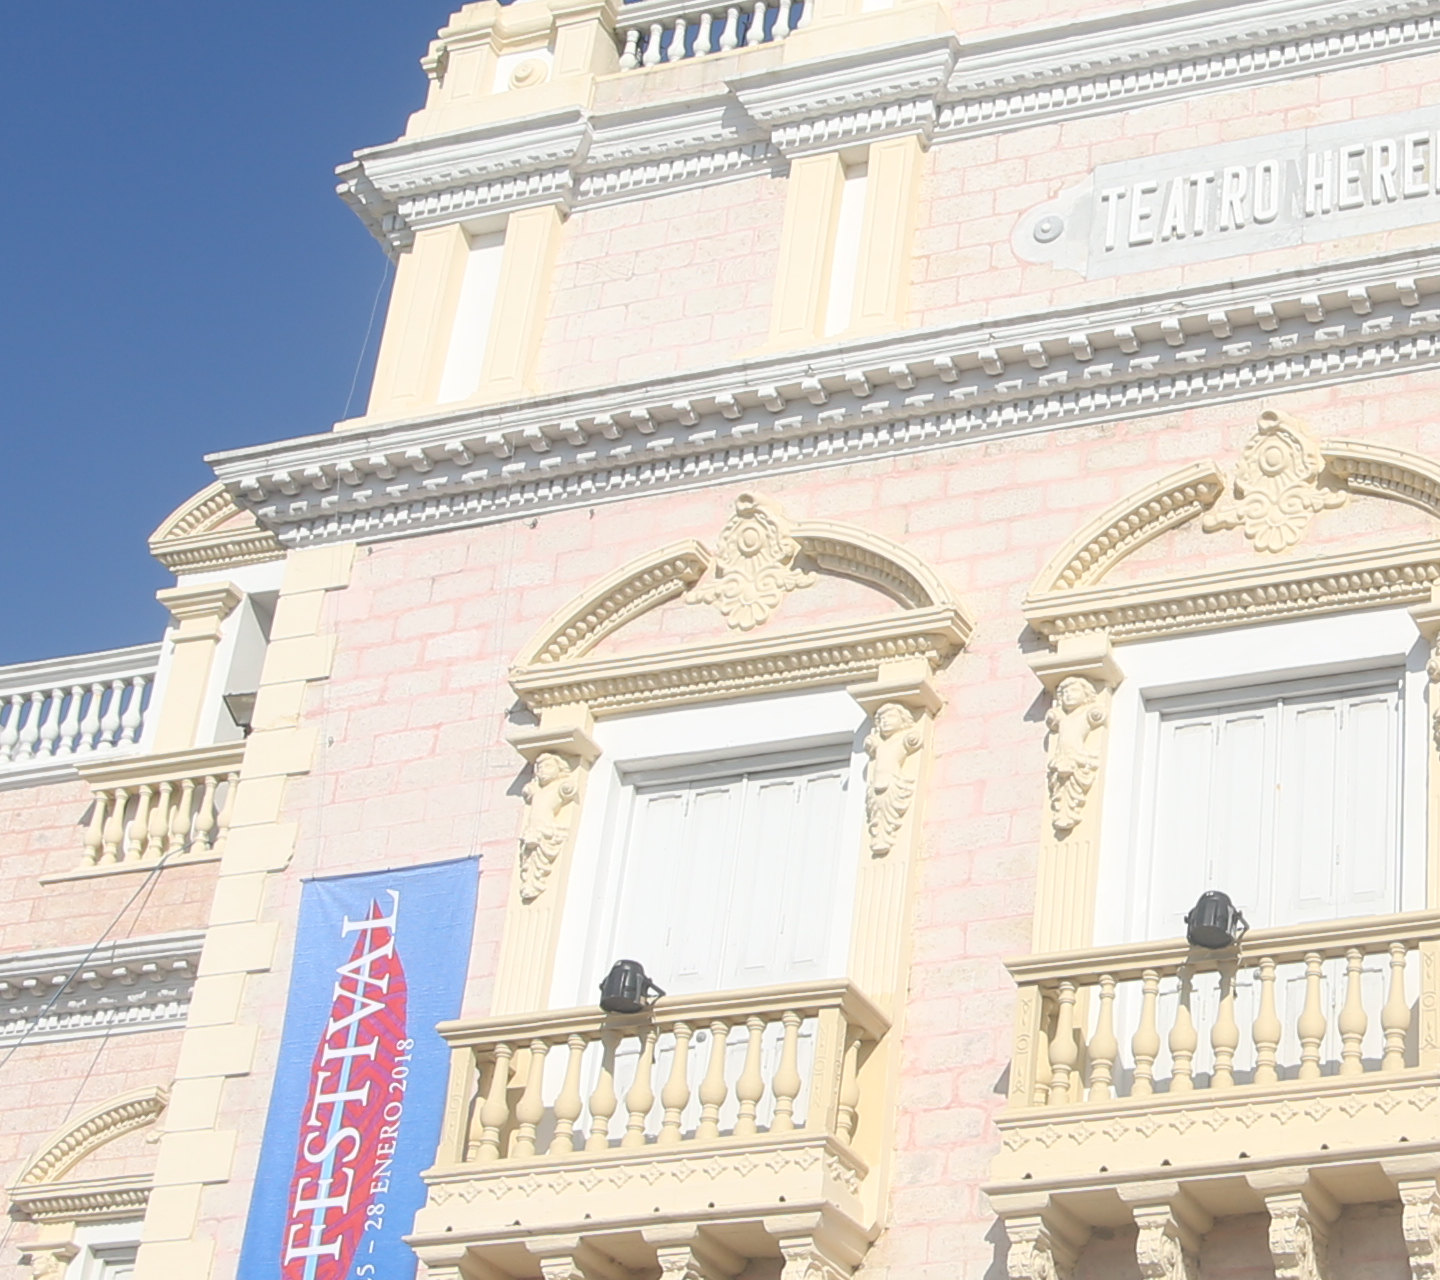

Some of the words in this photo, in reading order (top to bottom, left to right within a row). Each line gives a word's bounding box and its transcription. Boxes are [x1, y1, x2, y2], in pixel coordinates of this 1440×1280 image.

[1101, 158, 1280, 252] TEATRO
[284, 888, 401, 1263] FESTIVAL
[389, 1038, 414, 1094] 2018
[370, 1101, 403, 1197] ENERO
[364, 1204, 385, 1231] 28
